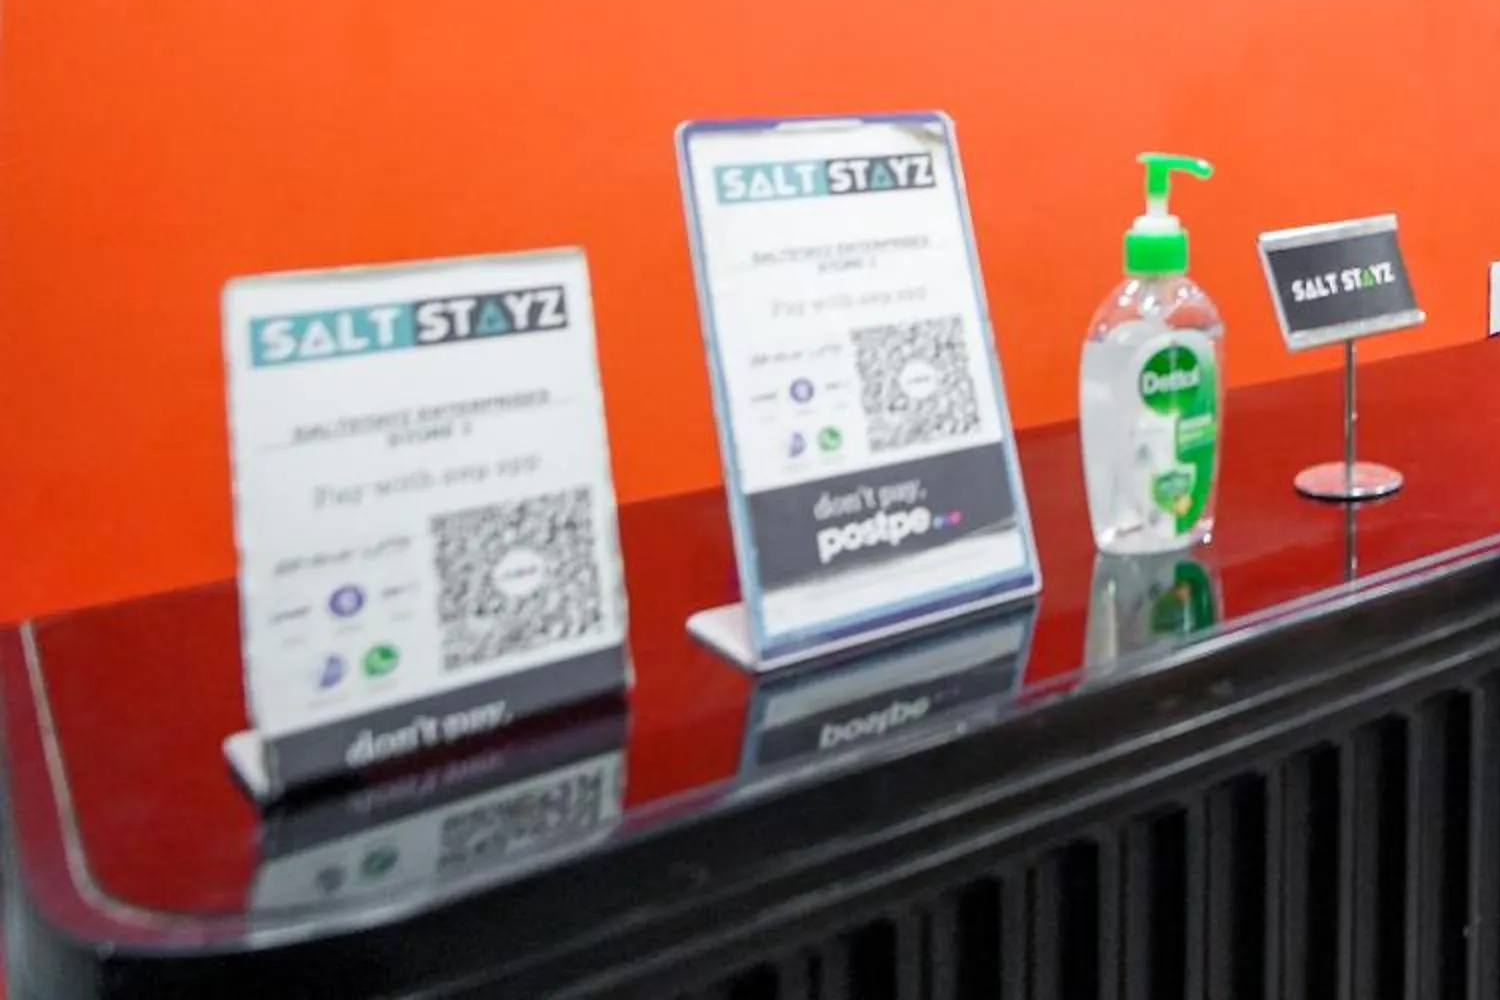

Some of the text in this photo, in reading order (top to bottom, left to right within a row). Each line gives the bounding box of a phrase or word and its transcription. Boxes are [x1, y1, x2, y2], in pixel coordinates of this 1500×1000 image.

[721, 155, 933, 199] SALT STAYZ
[1292, 262, 1396, 301] SALT STAYZ
[261, 289, 567, 361] SALT STAYZ
[814, 484, 877, 521] don't
[817, 506, 931, 564] postpe
